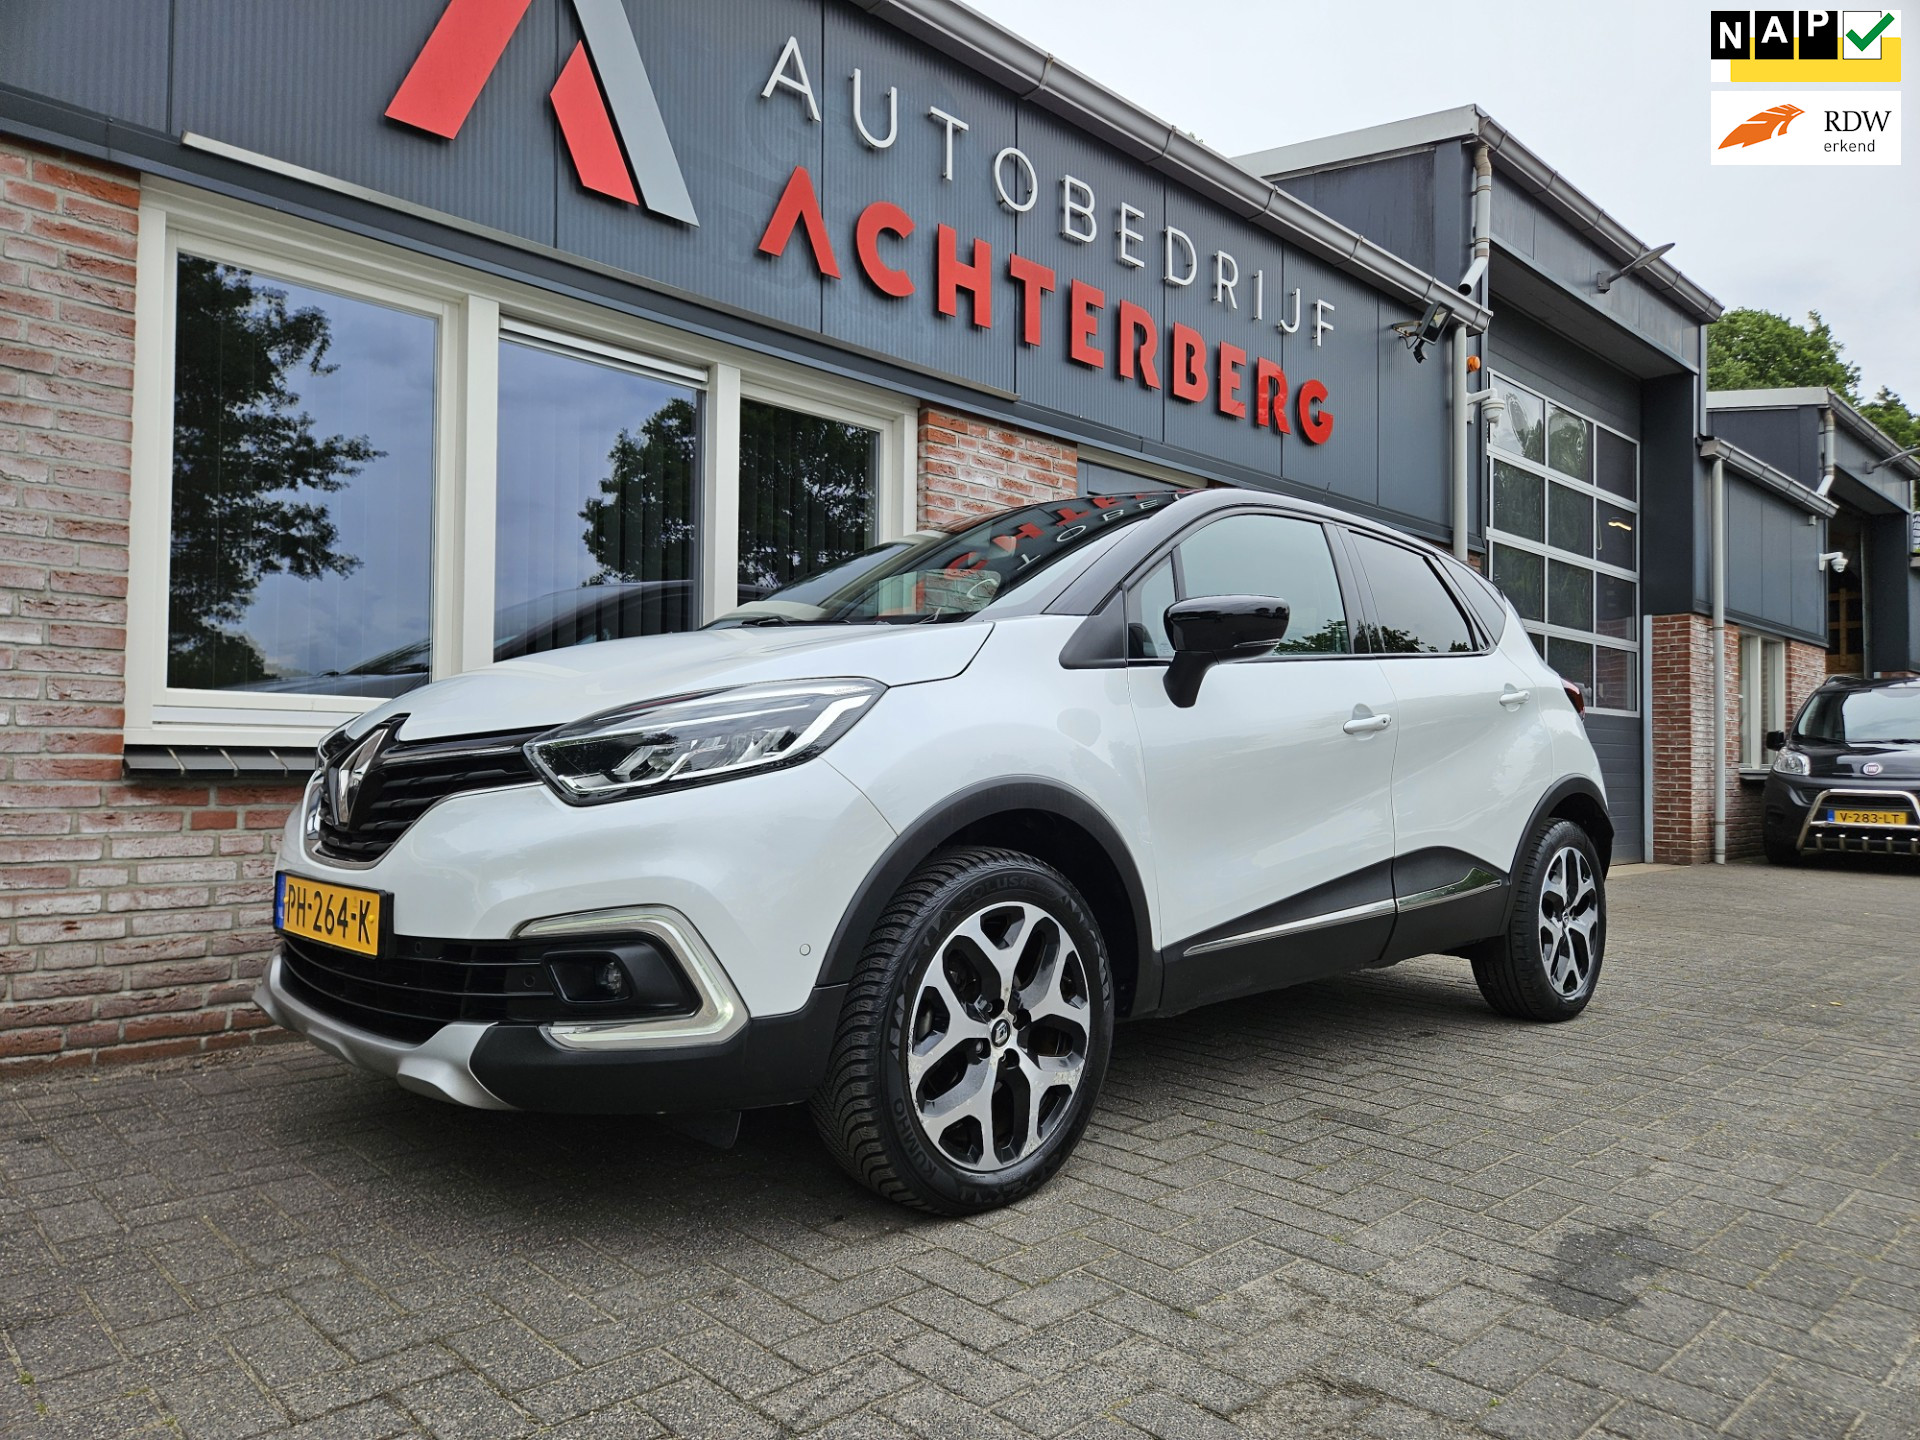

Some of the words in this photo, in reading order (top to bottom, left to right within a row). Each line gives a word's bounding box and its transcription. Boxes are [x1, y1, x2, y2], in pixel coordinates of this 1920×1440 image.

[761, 36, 1334, 347] AUTOBEDRIJF
[758, 165, 1334, 445] ACHTERBERG
[1839, 812, 1900, 824] V-283-LT
[287, 884, 371, 945] PH-264-K
[894, 1097, 938, 1179] KUMHO
